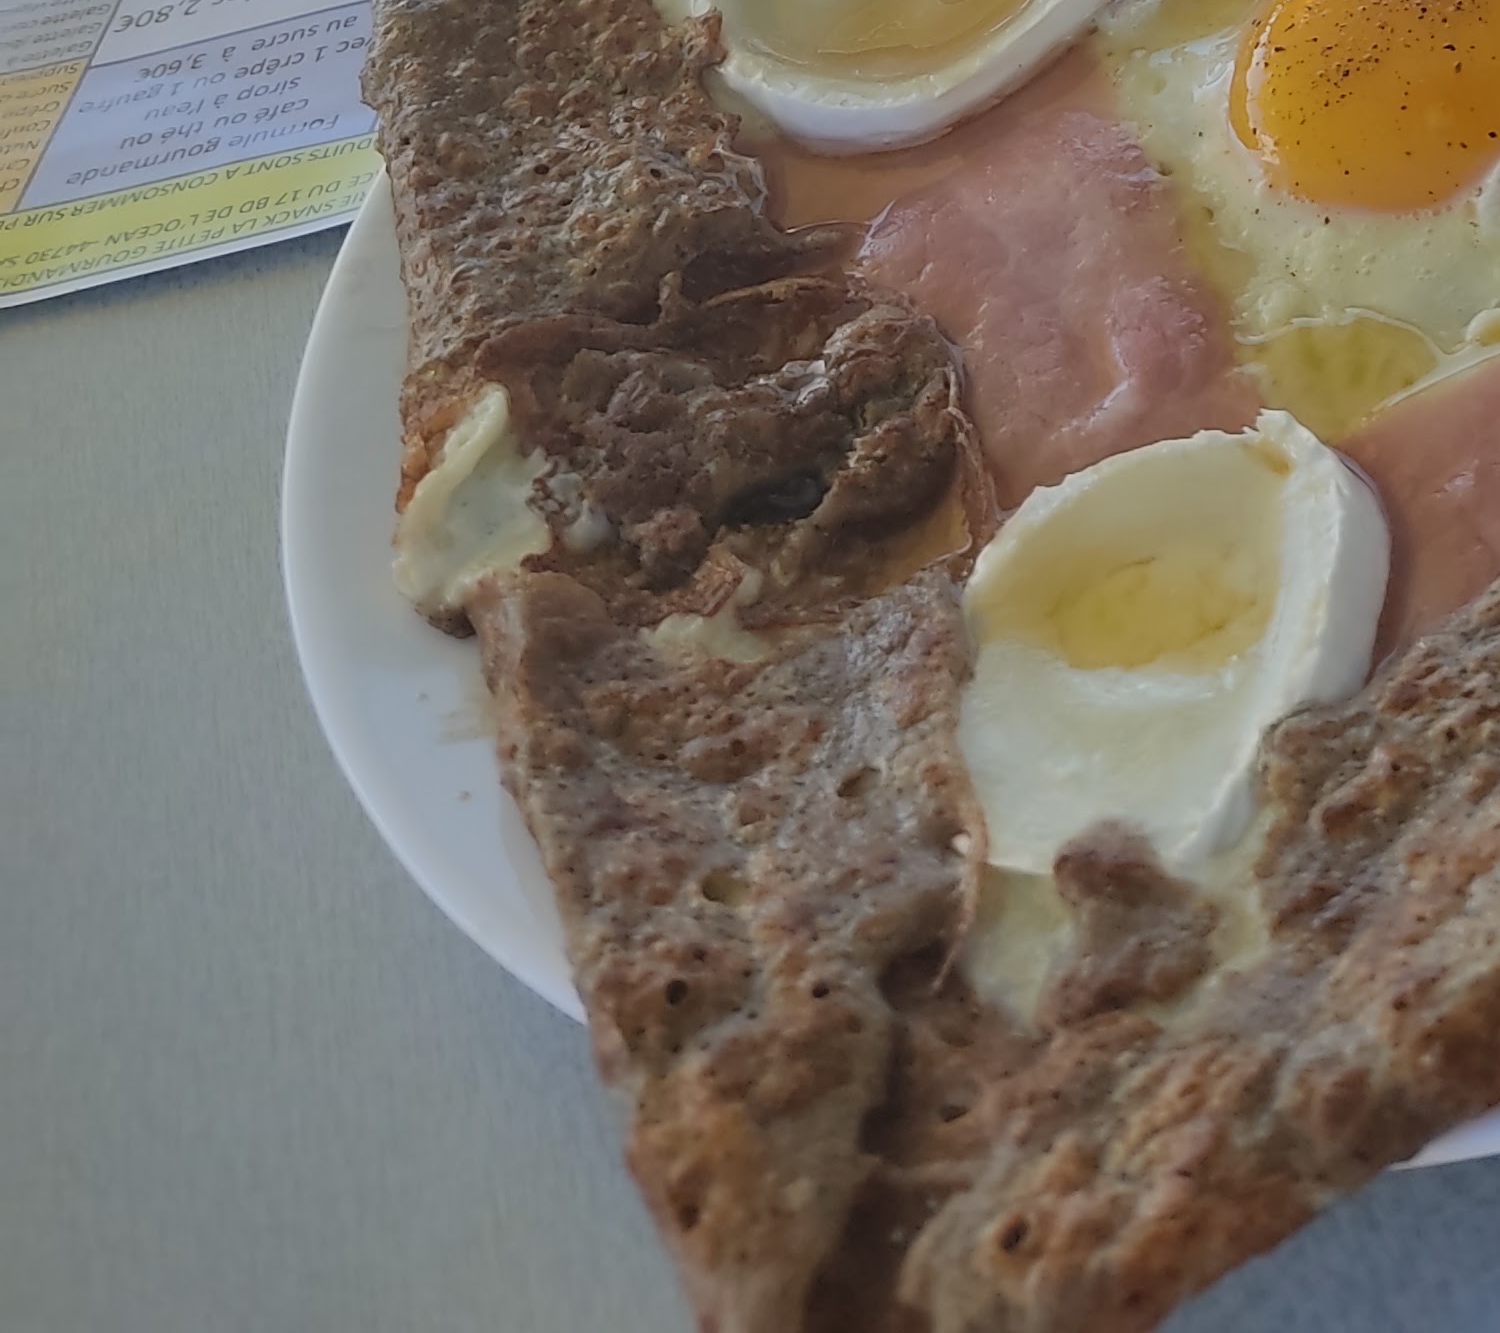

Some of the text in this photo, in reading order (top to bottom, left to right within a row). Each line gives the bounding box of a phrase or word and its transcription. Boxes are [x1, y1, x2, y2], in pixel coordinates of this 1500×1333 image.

[325, 15, 358, 33] au
[251, 23, 319, 52] sucre
[314, 45, 329, 63] 1
[233, 51, 306, 82] crêpe
[192, 72, 226, 89] ou
[235, 76, 302, 102] sirop
[213, 111, 248, 129] ou
[253, 98, 309, 123] café
[66, 114, 340, 186] Formule gourmande
[119, 132, 153, 150] ou
[307, 137, 373, 162] DUITS
[243, 151, 305, 176] SONT
[275, 188, 303, 206] 17
[307, 180, 341, 198] DU
[202, 205, 234, 223] DE
[239, 196, 270, 214] BD
[264, 198, 337, 226] SNACK
[24, 207, 69, 227] SUR
[232, 218, 258, 234] LA
[152, 227, 225, 254] PETITE
[0, 245, 148, 290] GOURMANDI
